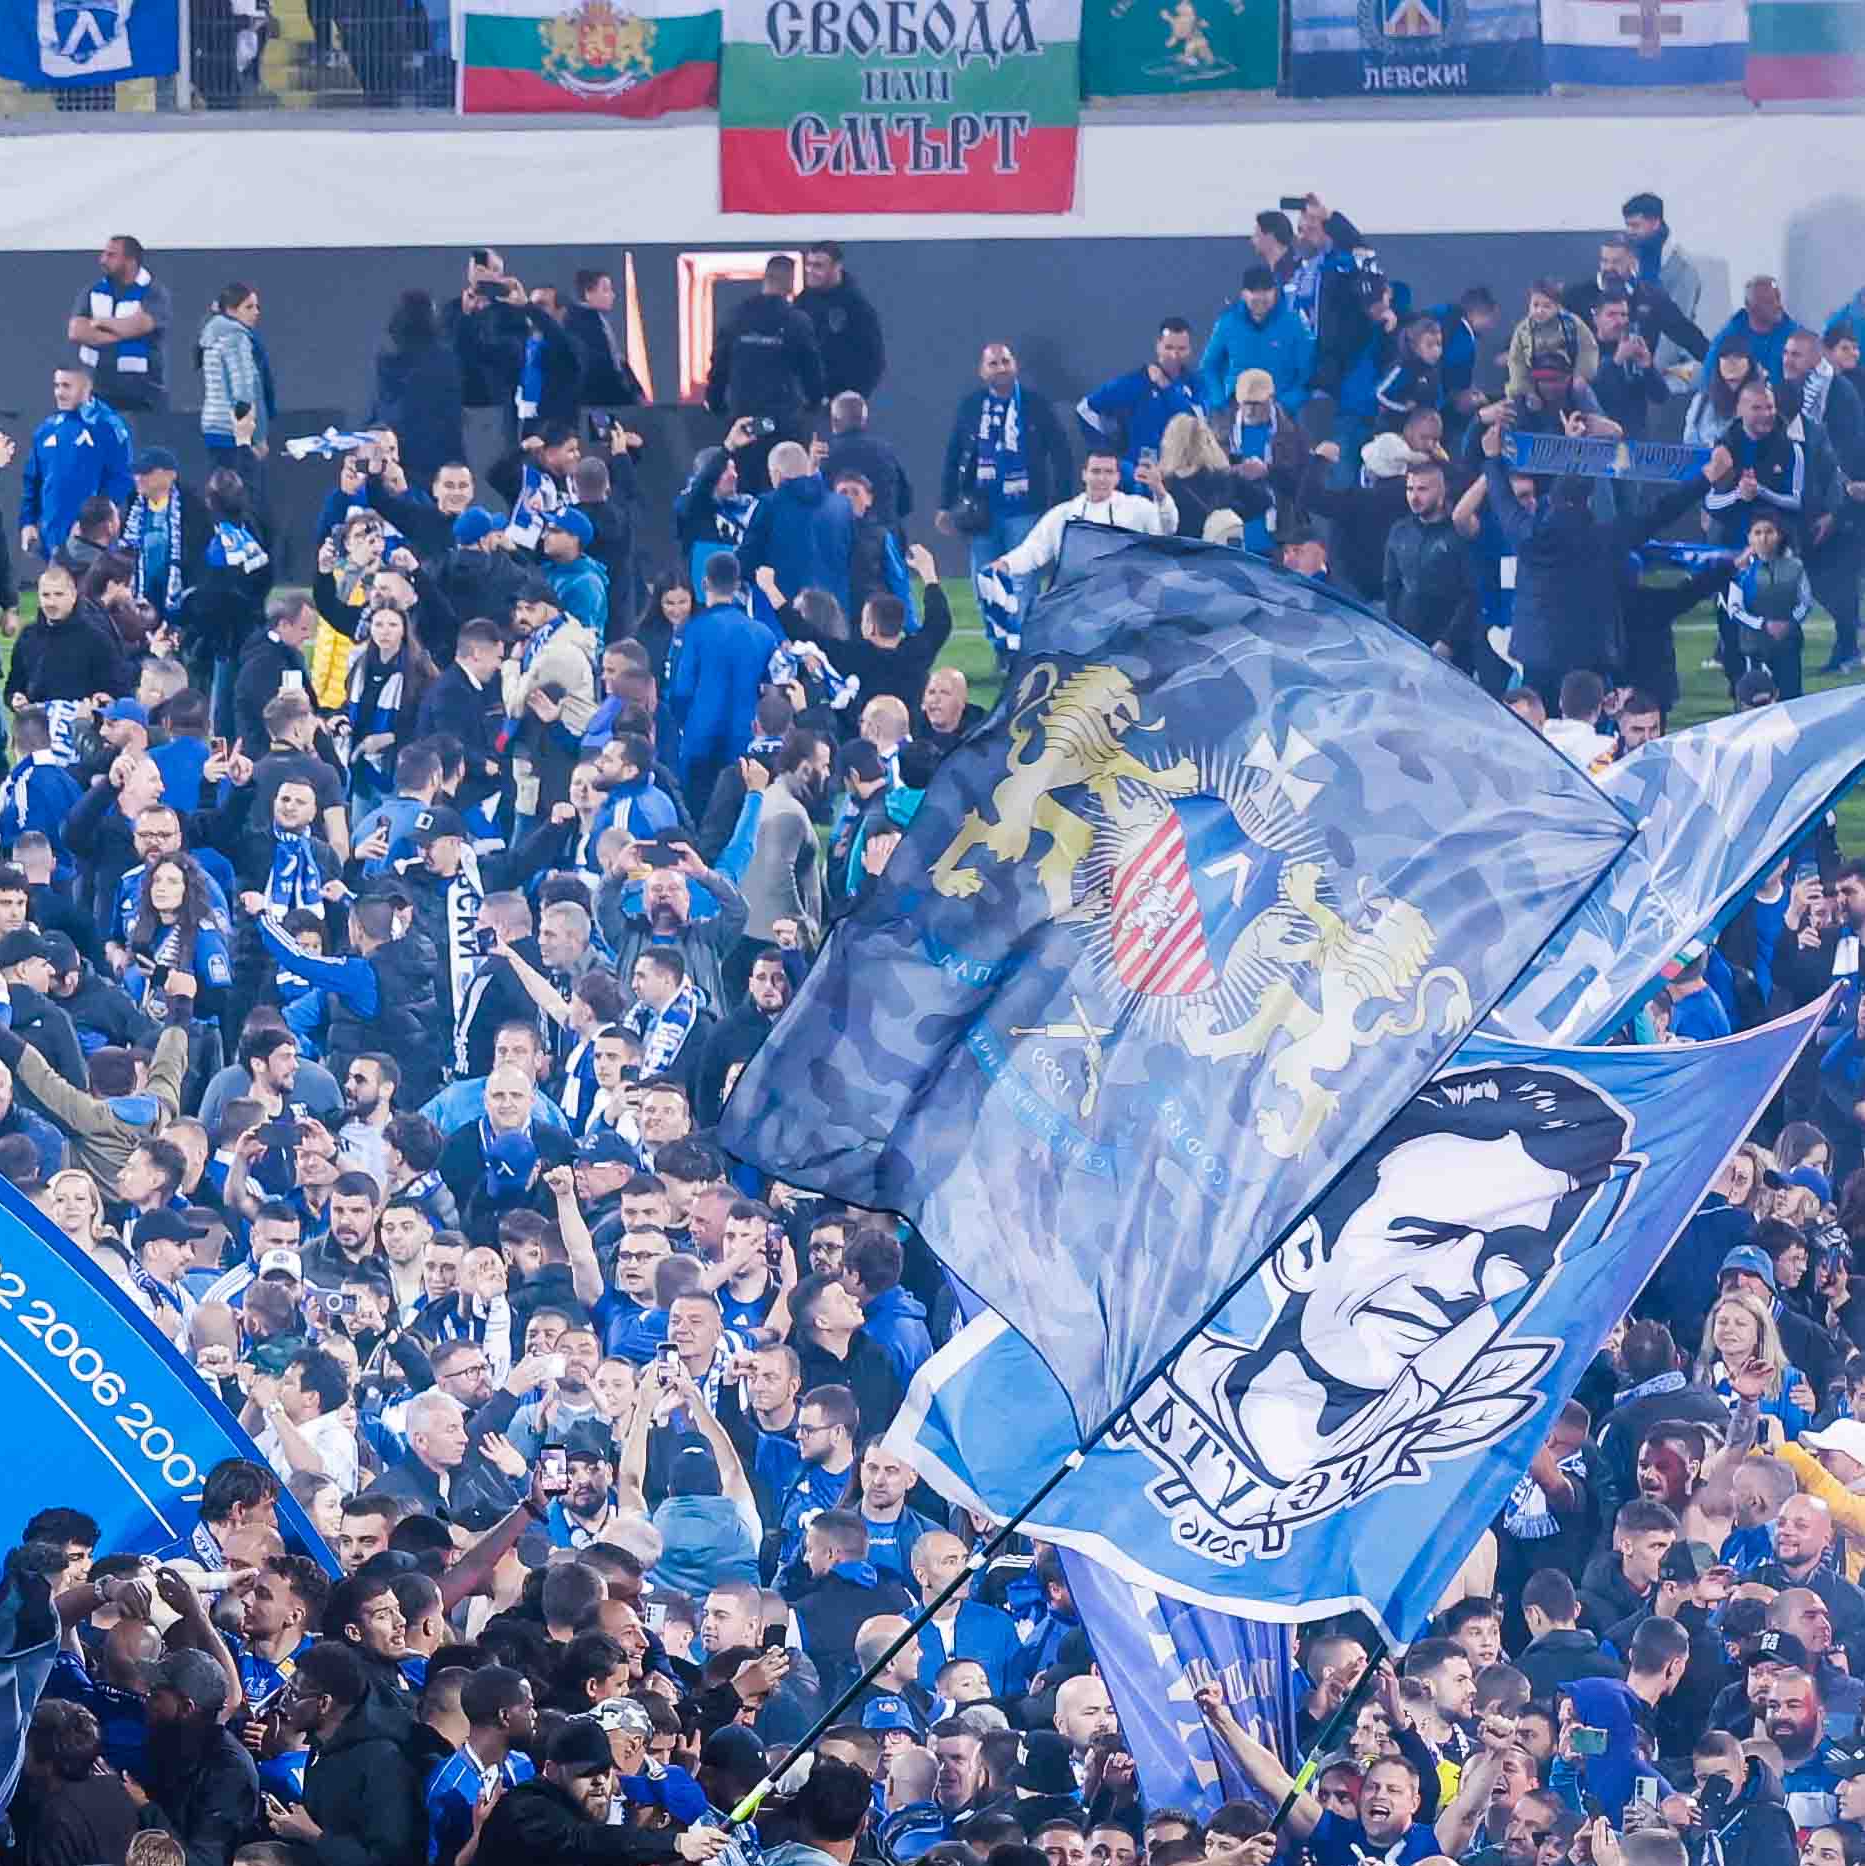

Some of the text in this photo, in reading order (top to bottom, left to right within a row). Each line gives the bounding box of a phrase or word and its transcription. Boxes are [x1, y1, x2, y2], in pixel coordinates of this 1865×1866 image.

[765, 0, 1041, 69] СВОБОДА
[1363, 62, 1469, 90] ЛЕВСКИ!
[787, 112, 1029, 176] СМЪРТ
[15, 1299, 129, 1409] 2006
